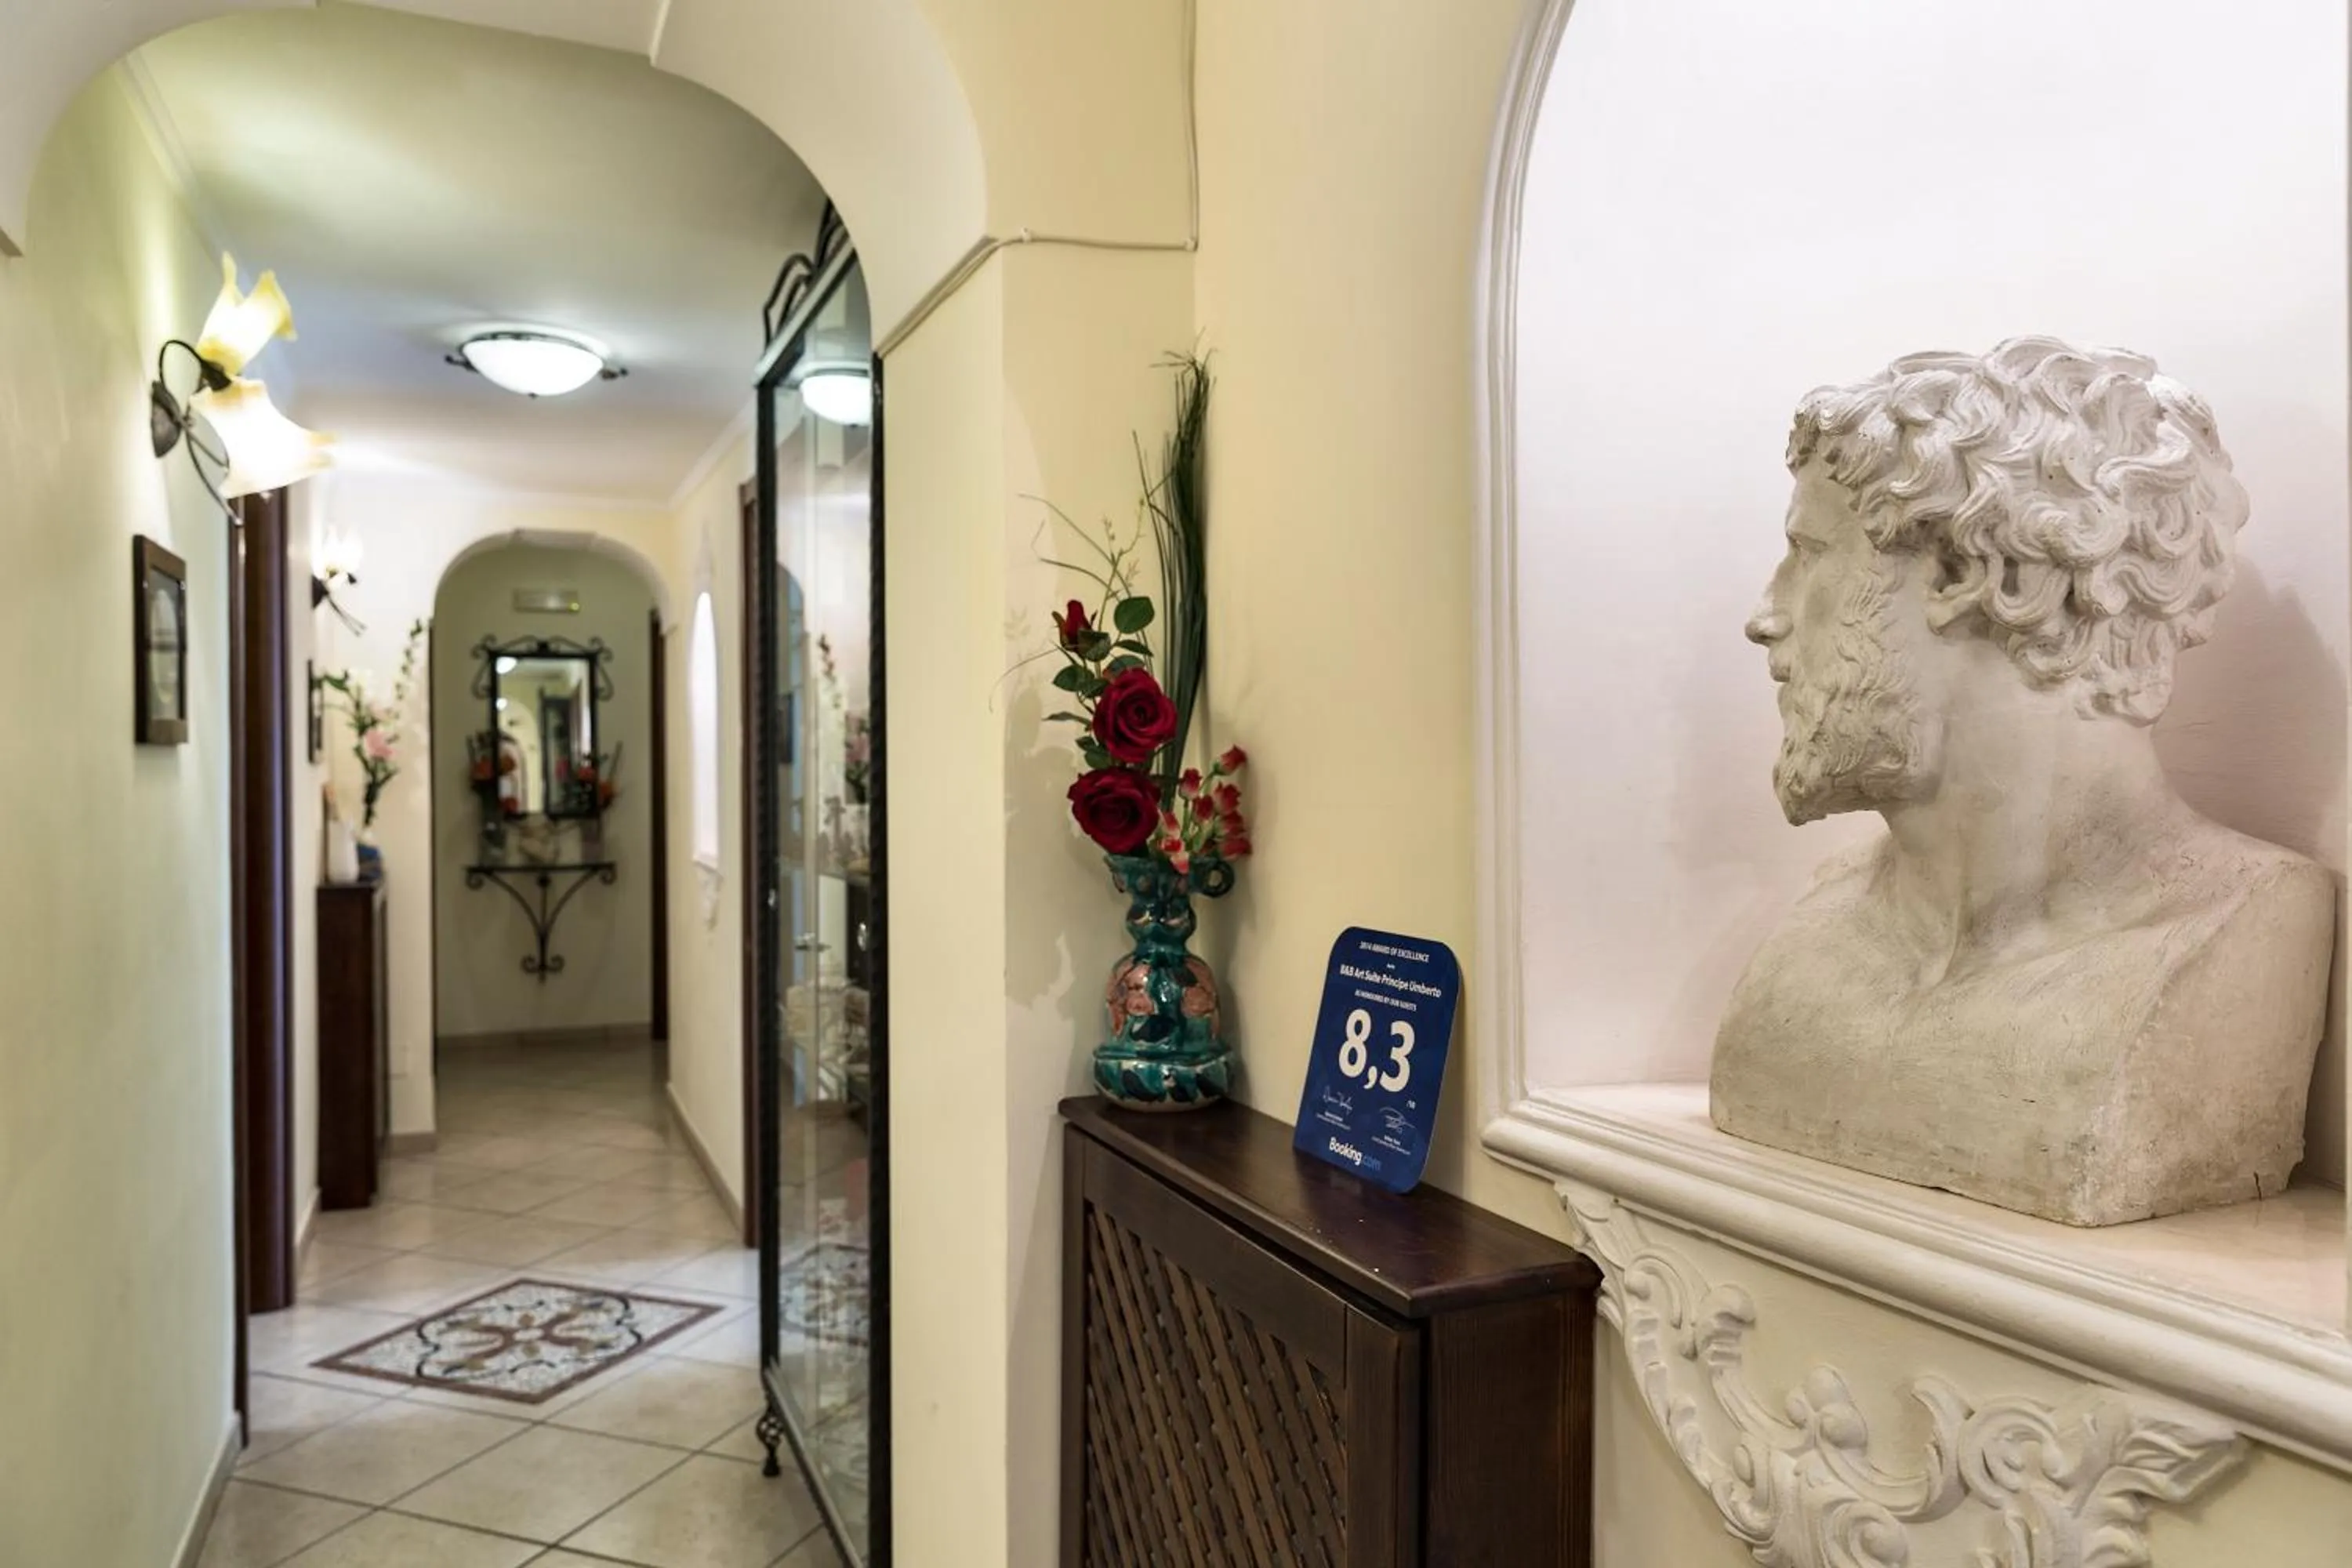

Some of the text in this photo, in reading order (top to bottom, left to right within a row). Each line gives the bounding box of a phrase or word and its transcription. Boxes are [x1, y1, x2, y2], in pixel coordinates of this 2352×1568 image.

[1390, 947, 1397, 956] OF
[1396, 948, 1429, 963] EXCELLENCE
[1340, 964, 1442, 998] B&B Art Suite Principe Umberto
[1338, 1008, 1415, 1092] 8,3
